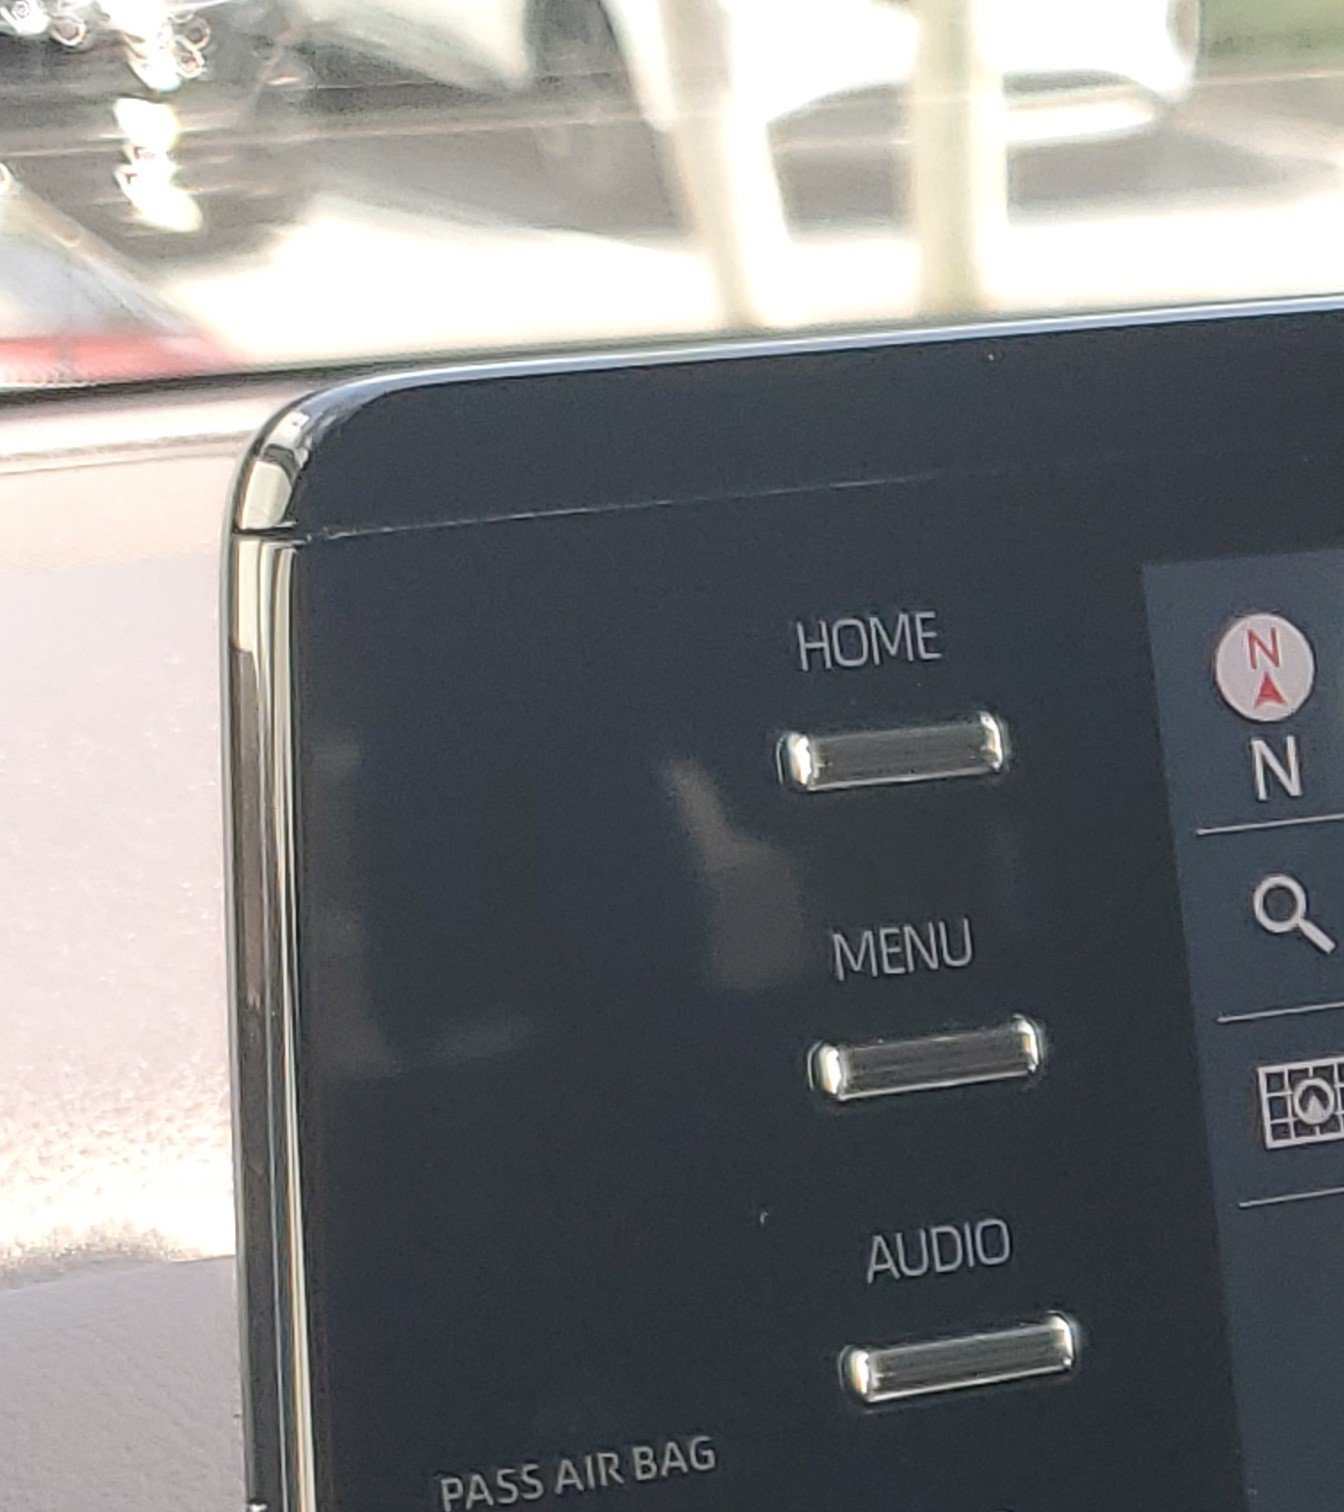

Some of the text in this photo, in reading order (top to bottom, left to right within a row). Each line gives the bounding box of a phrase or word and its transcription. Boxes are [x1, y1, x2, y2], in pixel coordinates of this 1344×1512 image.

[797, 611, 941, 671] HOME
[1251, 737, 1303, 798] N
[832, 918, 975, 982] MENU
[866, 1219, 1013, 1284] AUDIO
[440, 1436, 718, 1512] PASS AIR BAG
